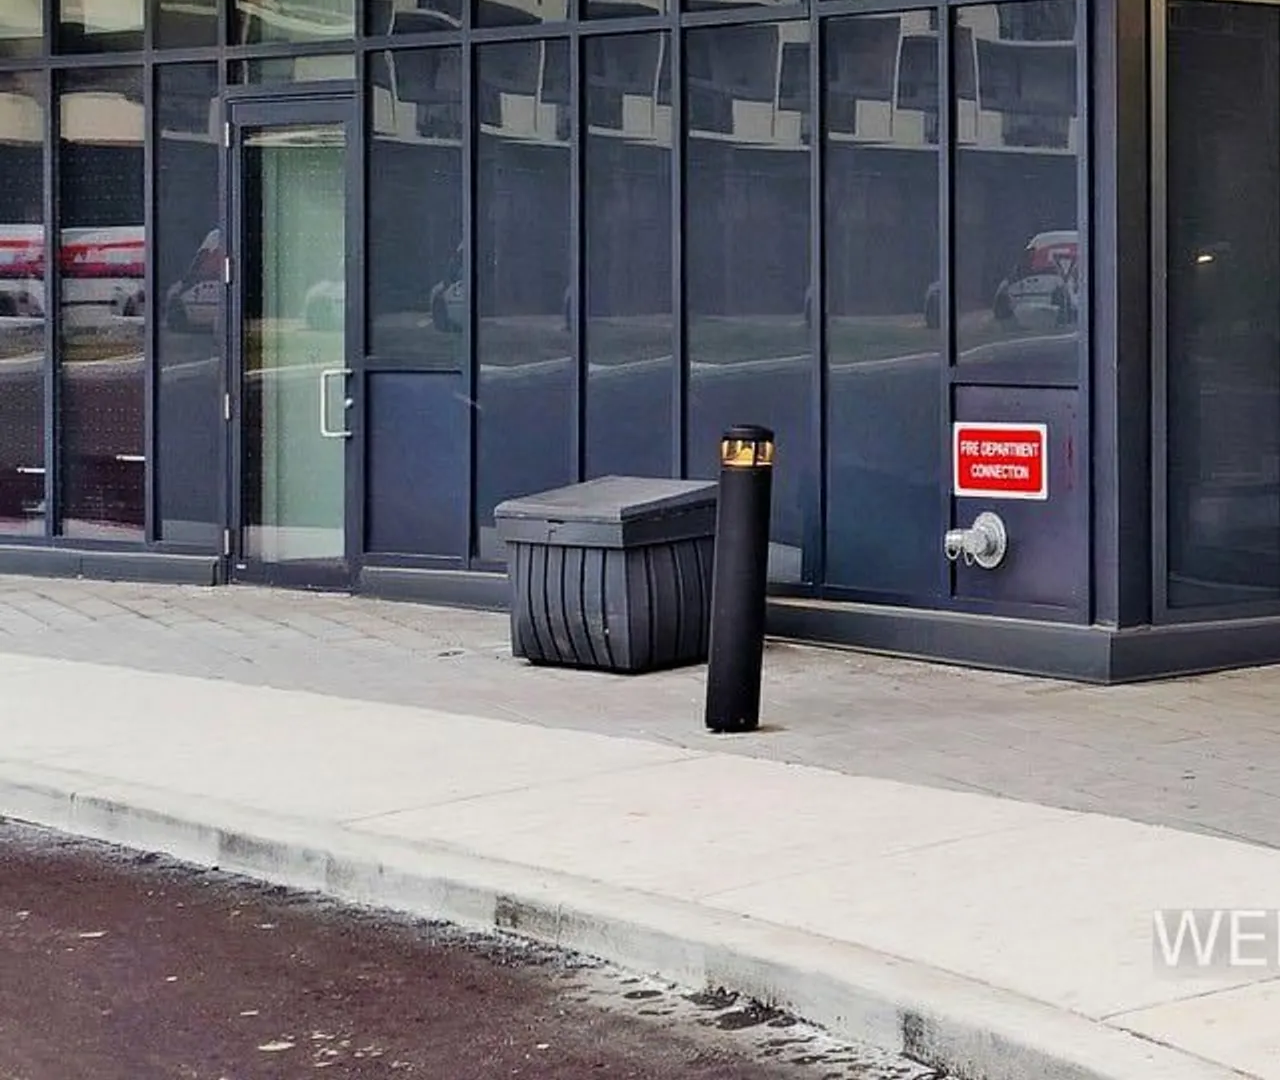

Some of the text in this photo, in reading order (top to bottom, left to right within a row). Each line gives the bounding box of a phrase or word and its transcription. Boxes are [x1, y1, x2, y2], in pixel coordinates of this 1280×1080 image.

[960, 440, 1040, 457] FIRE DEPARTMENT
[970, 463, 1030, 480] CONNECTION
